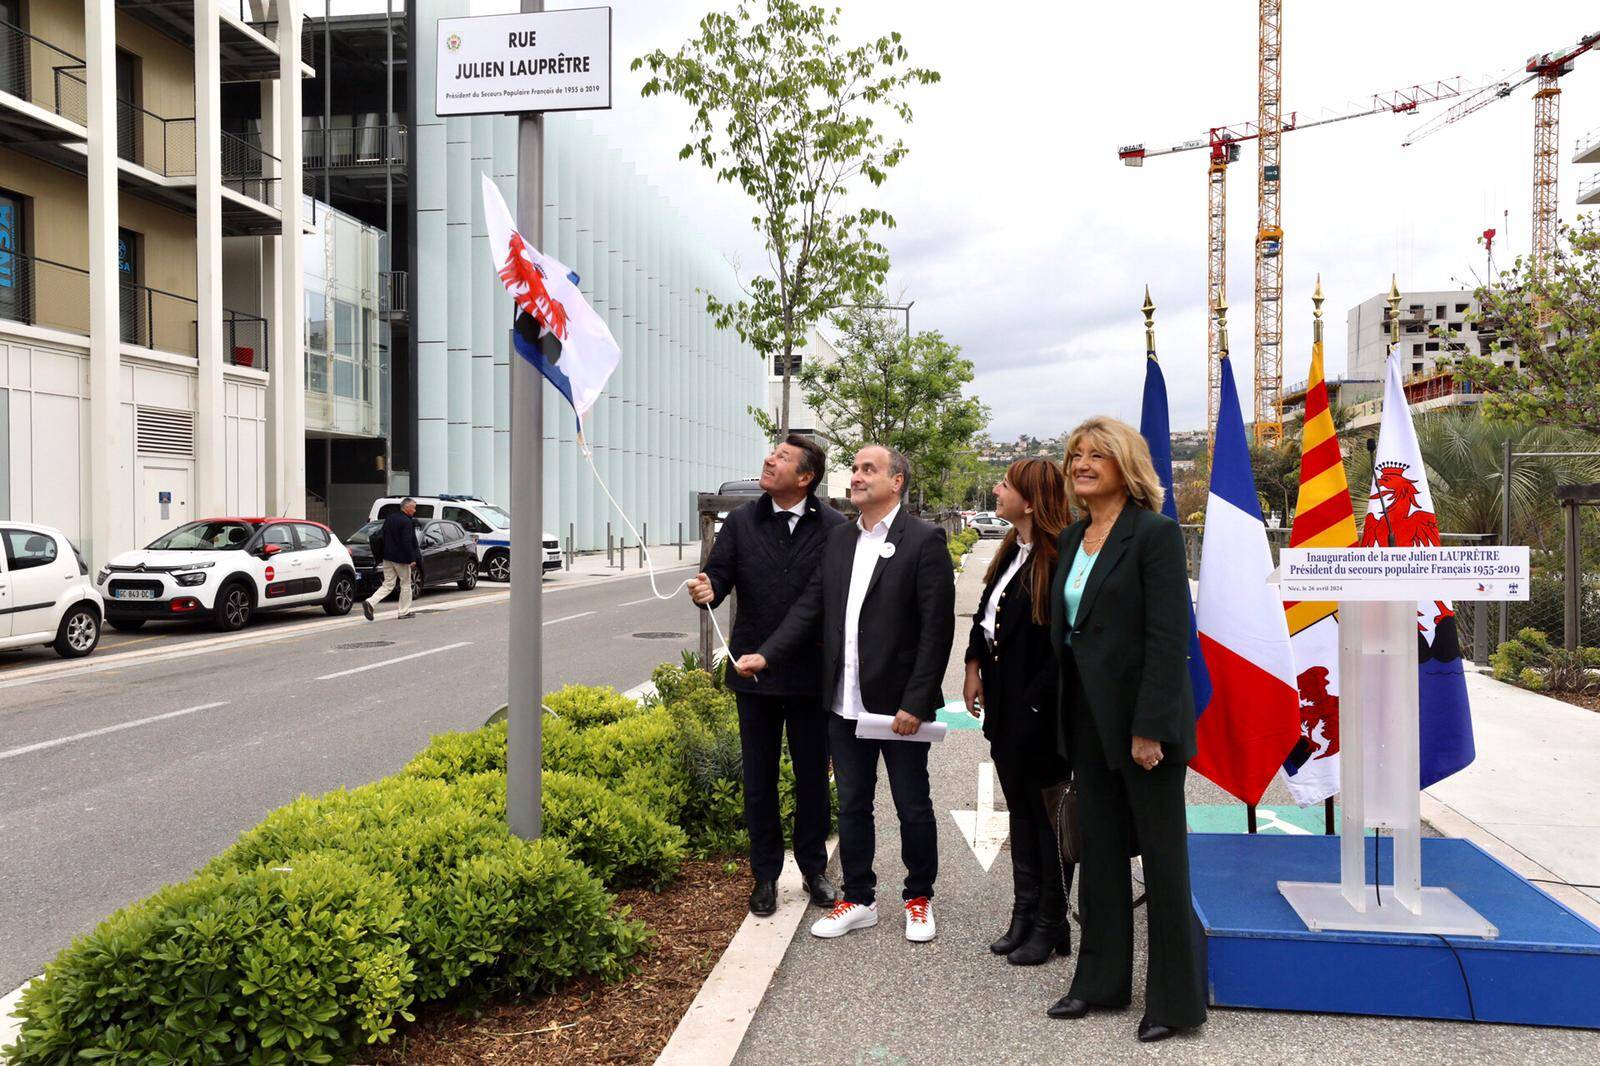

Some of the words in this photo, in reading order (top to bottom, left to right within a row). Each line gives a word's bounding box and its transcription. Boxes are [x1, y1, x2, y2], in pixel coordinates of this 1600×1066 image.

[508, 31, 536, 48] RUE
[455, 61, 504, 80] JULIEN
[510, 52, 590, 77] LAUPRÊTRE
[503, 89, 530, 97] Populaire
[531, 87, 554, 95] Français
[555, 86, 563, 94] de
[1306, 552, 1365, 564] Inauguration
[1367, 551, 1378, 562] de
[1380, 551, 1389, 562] la
[1391, 553, 1407, 562] rue
[1408, 550, 1438, 561] Julien
[1440, 549, 1500, 561] LAUPRÊTRE
[1290, 564, 1332, 575] Président
[1334, 564, 1346, 574] du
[1348, 565, 1383, 574] secours
[1385, 563, 1429, 576] populaire
[1431, 563, 1471, 576] Français
[1473, 565, 1521, 576] 1955-2019
